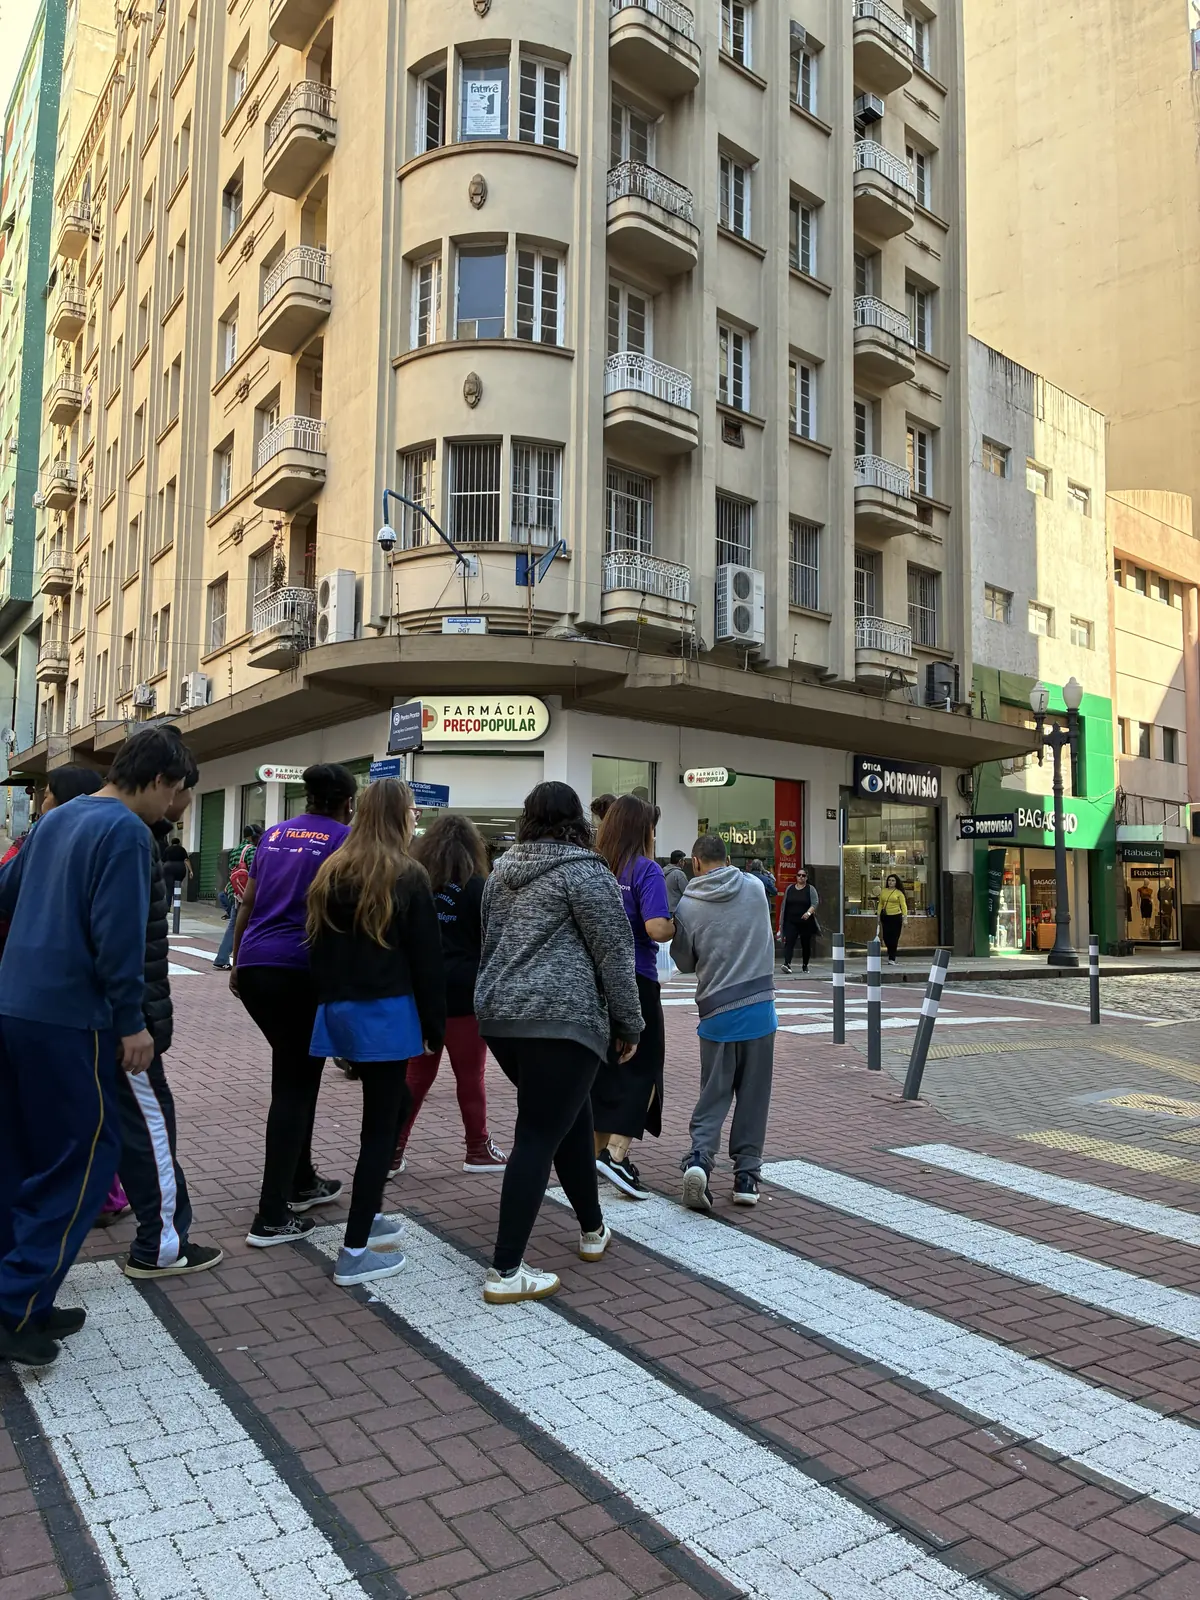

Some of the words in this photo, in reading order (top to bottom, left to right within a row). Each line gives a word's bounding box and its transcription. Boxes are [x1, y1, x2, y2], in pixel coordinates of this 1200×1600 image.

[443, 702, 535, 716] FARMÁCIA
[443, 718, 536, 735] PREÇOPOPULAR
[862, 761, 882, 772] ÓTICA
[285, 830, 330, 842] TALENTOS
[1124, 848, 1161, 858] Rabusch
[1133, 869, 1169, 877] Rabusch
